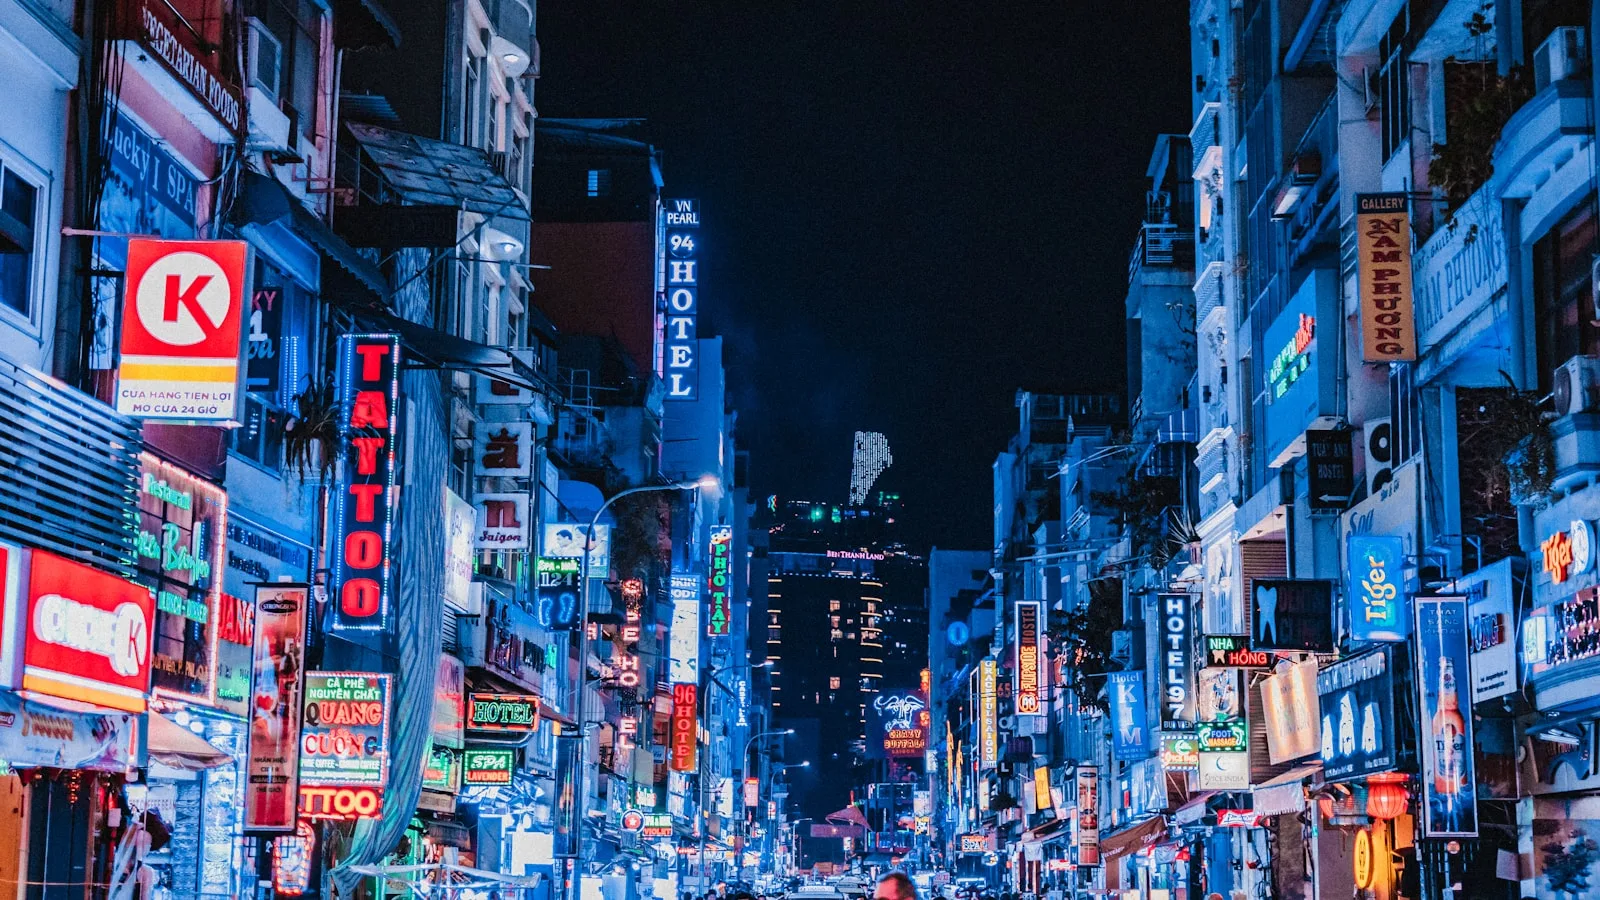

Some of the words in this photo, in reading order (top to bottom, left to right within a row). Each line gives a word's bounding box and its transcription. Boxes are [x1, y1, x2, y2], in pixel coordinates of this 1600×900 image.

[209, 74, 239, 130] FOODS
[167, 163, 195, 214] SPA
[676, 200, 691, 212] VN
[1361, 198, 1405, 209] GALLERY
[667, 213, 699, 224] PEARL
[671, 235, 694, 251] 94
[670, 261, 696, 396] HOTEL
[341, 345, 390, 618] TATTOO
[479, 530, 523, 546] Saigon
[1541, 531, 1573, 585] Tiger
[1366, 555, 1397, 623] Tiger
[1209, 638, 1234, 650] NHA
[1111, 674, 1141, 685] Hotel
[675, 684, 696, 704] 96
[306, 701, 383, 727] QUANG
[473, 701, 534, 726] HOTEL
[675, 705, 692, 769] HOTEL
[888, 729, 922, 739] CRAZY
[1211, 730, 1232, 739] FOOT
[1208, 738, 1237, 748] MASSAGE
[471, 757, 506, 770] SPA
[467, 770, 509, 782] LAVENDER
[644, 827, 671, 836] VIOLET
